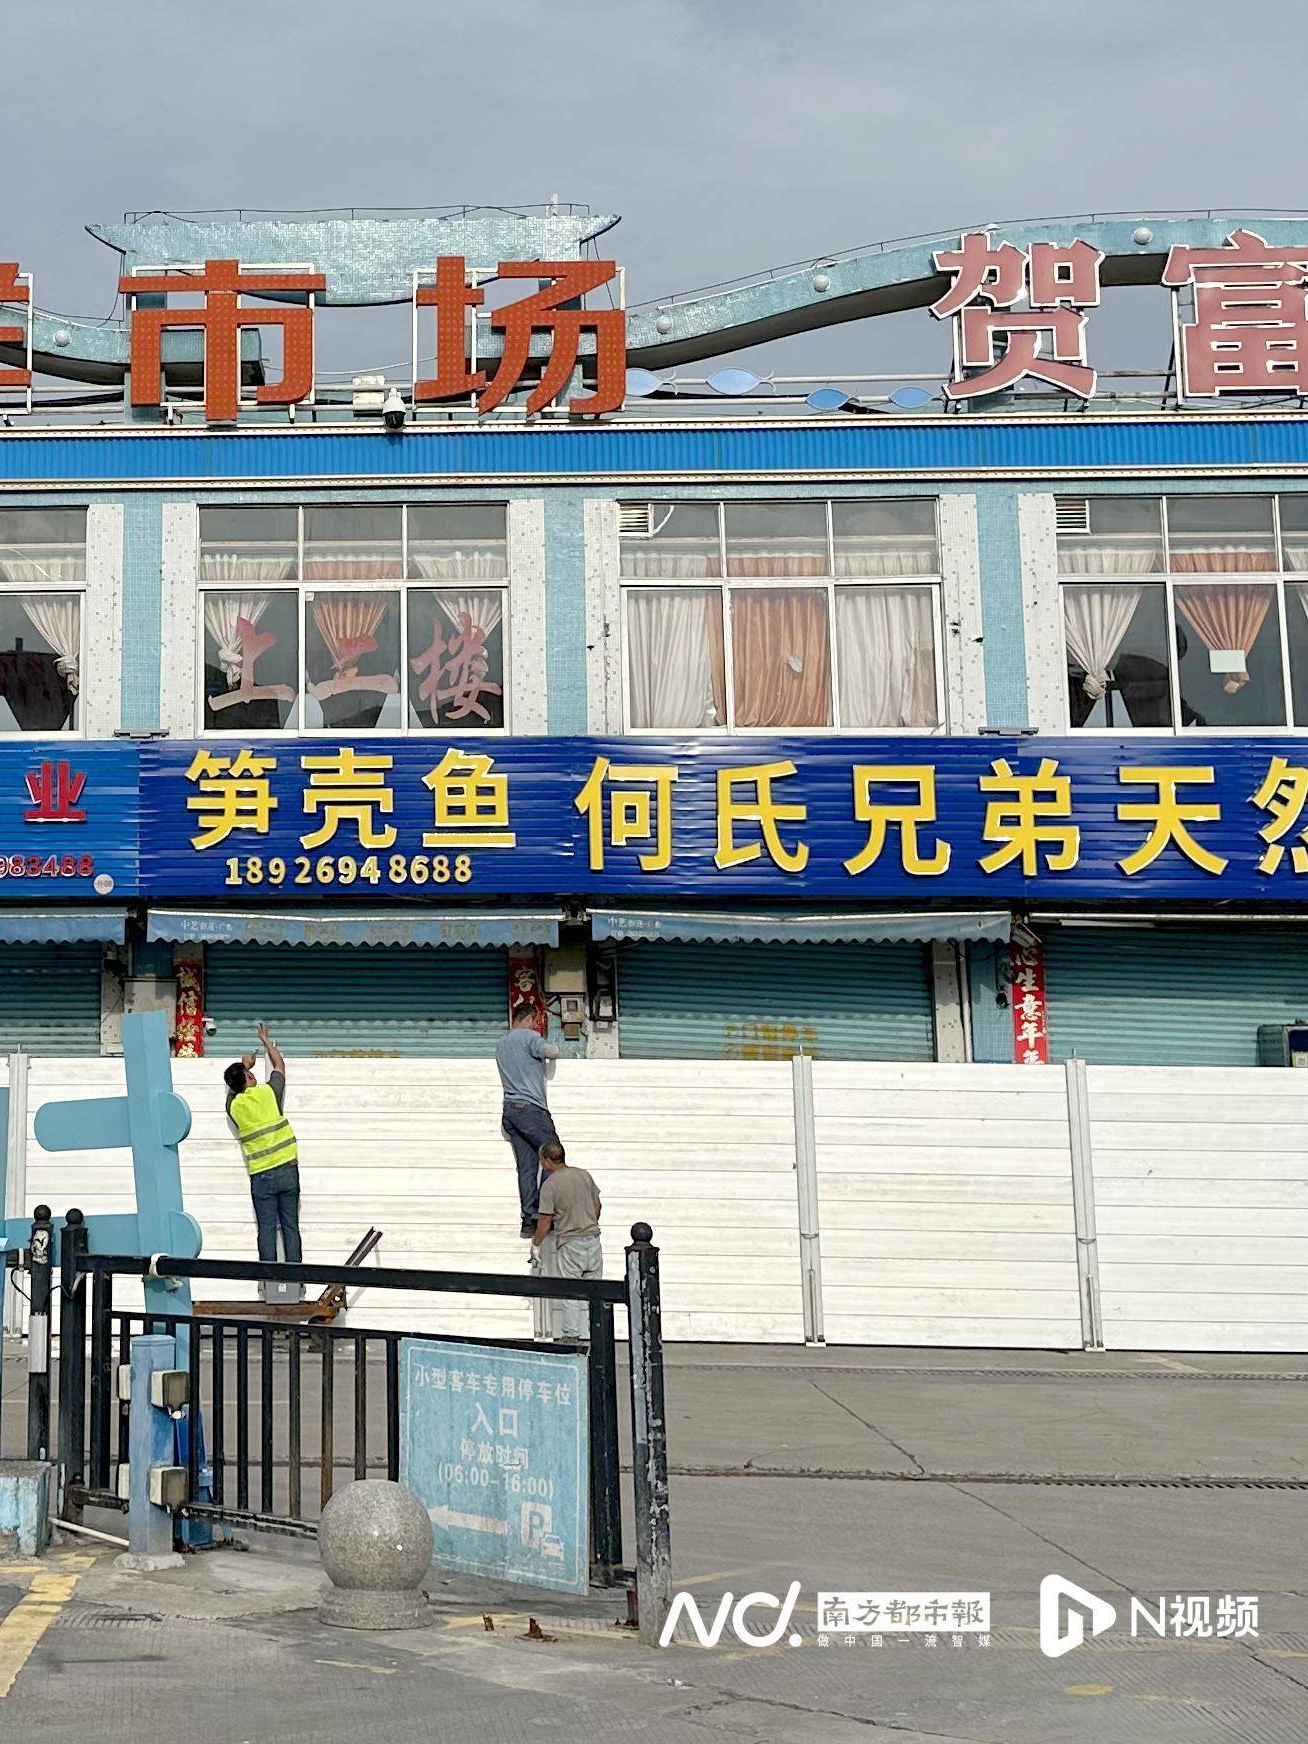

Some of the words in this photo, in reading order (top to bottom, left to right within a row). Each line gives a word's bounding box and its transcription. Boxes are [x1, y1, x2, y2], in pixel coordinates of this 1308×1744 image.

[184, 747, 516, 851] 笋壳鱼
[414, 1365, 572, 1405] 小型客车专用停车位
[471, 1402, 519, 1438] 入口
[460, 1438, 529, 1471] 停放时间
[521, 1502, 552, 1548] P
